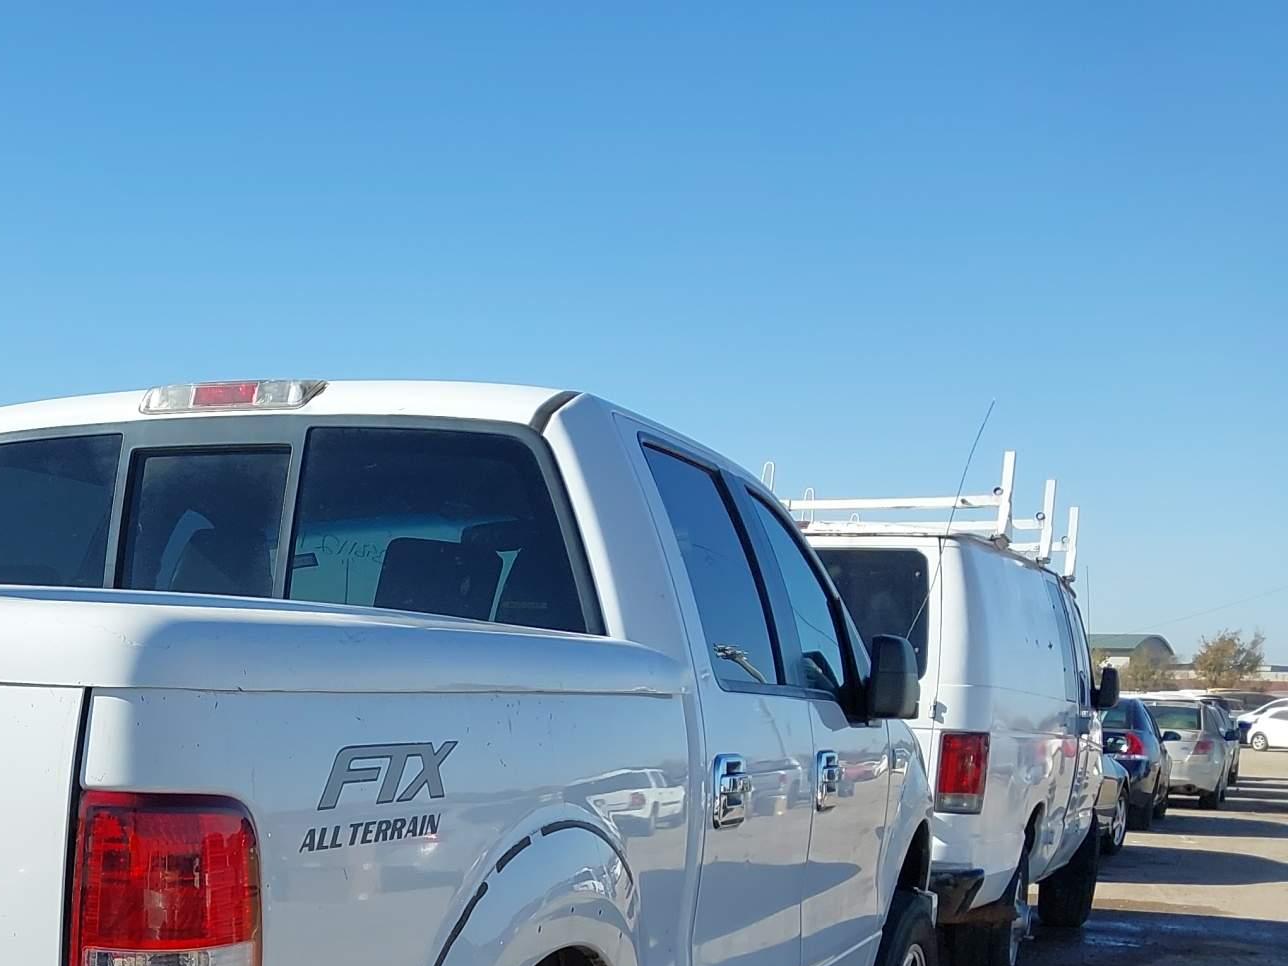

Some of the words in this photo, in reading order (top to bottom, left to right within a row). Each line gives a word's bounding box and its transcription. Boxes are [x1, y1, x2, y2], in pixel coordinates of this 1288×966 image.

[317, 740, 459, 810] FTX
[298, 825, 343, 853] ALL
[349, 813, 441, 845] TERRAIN
